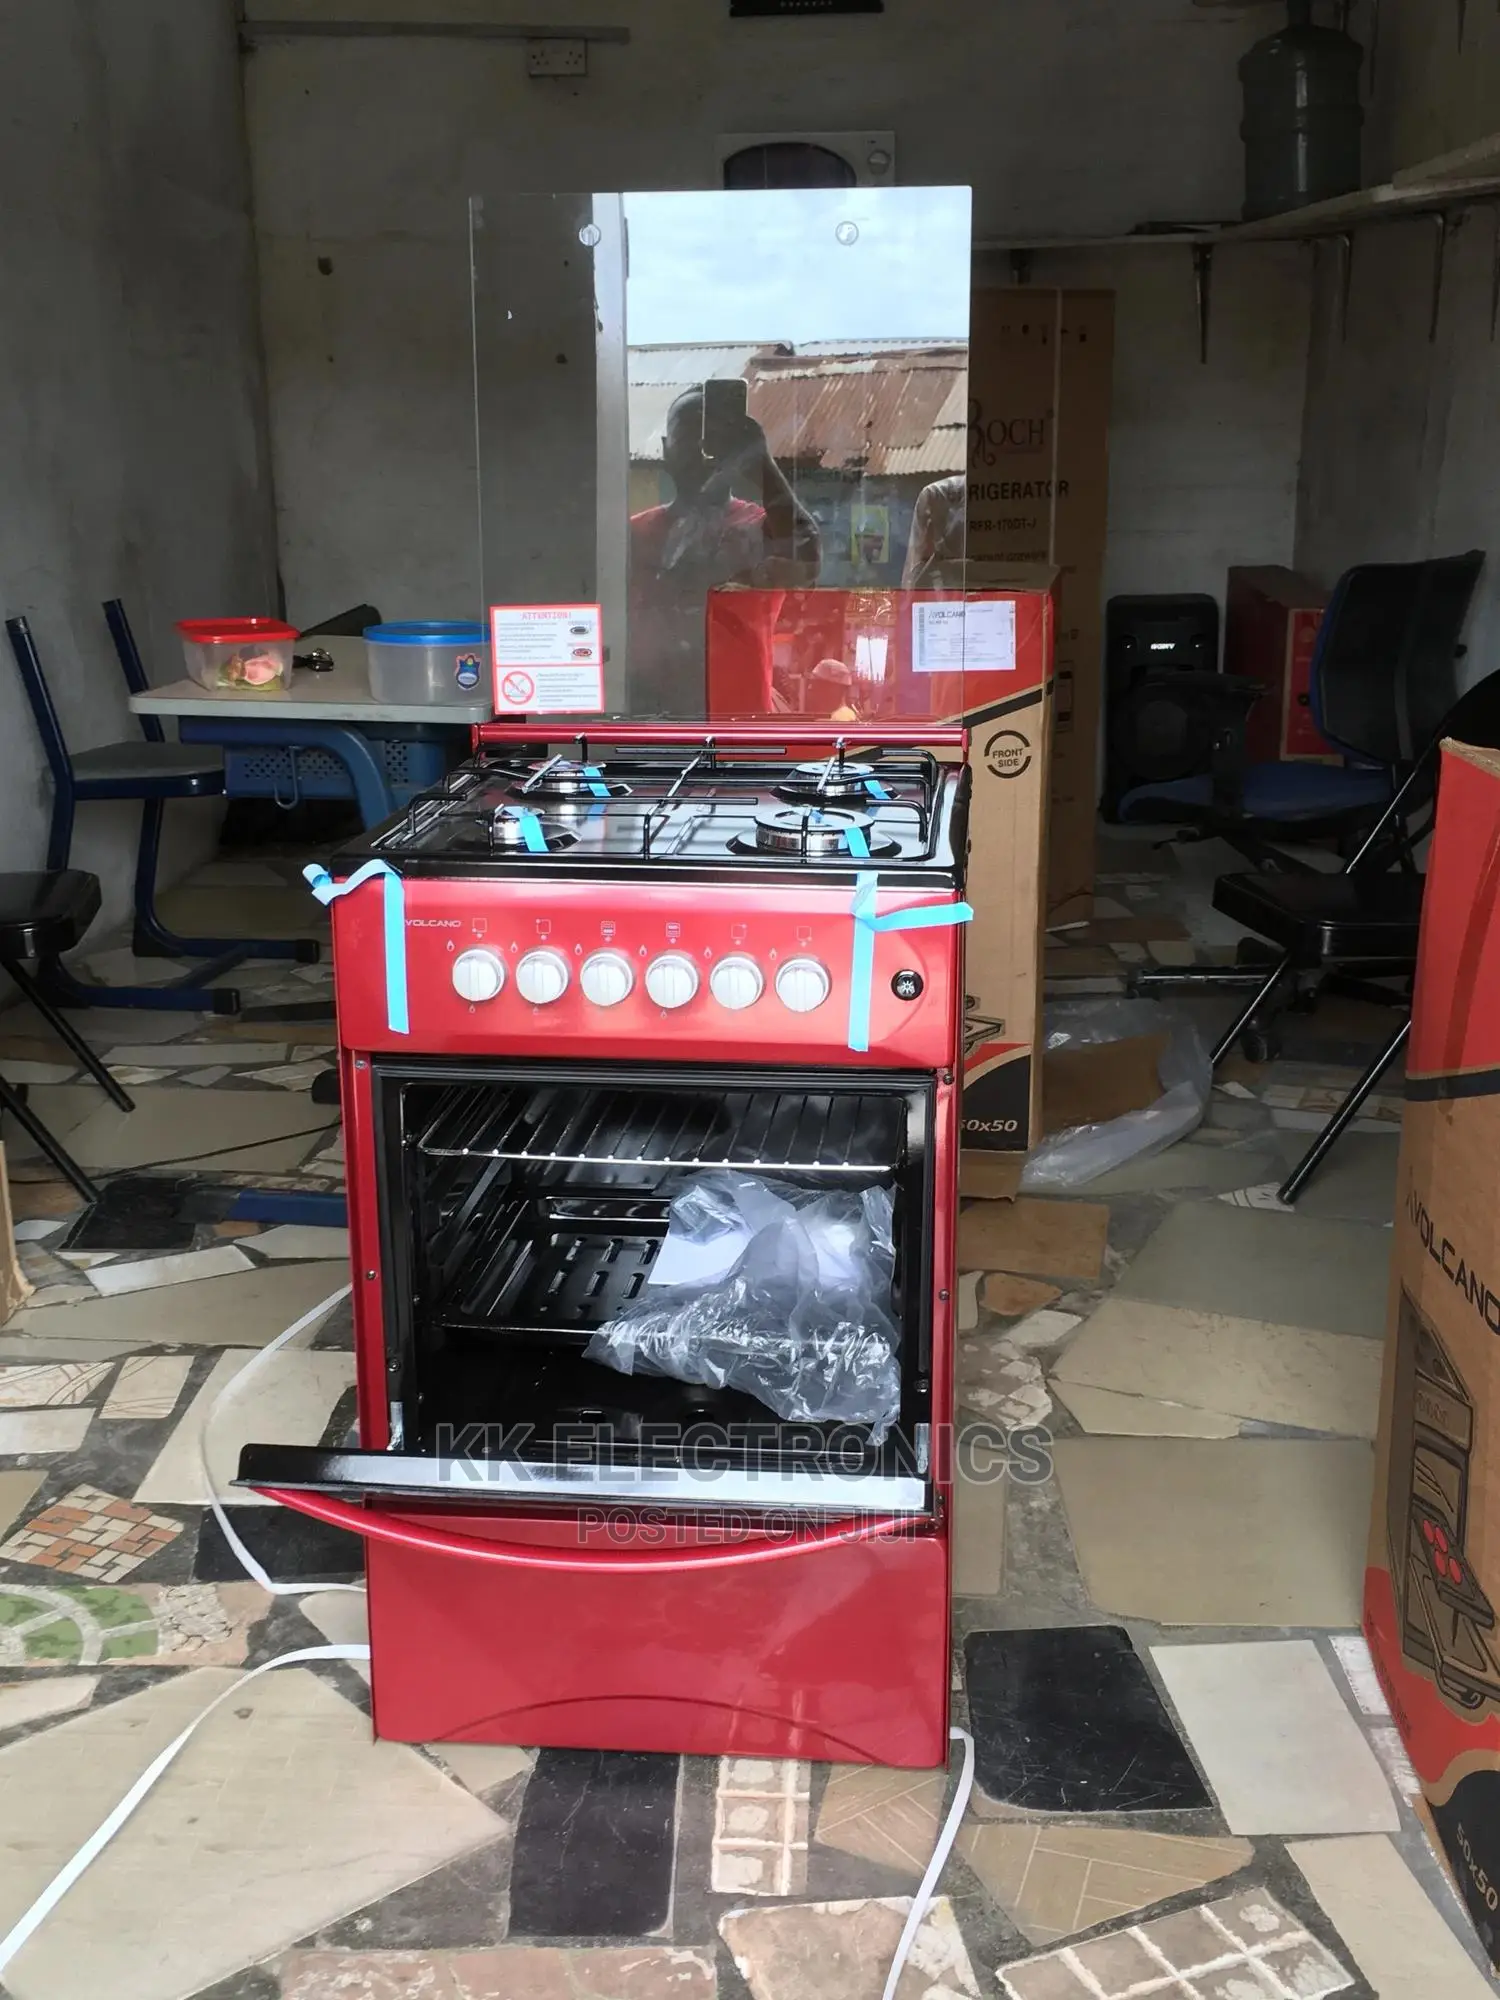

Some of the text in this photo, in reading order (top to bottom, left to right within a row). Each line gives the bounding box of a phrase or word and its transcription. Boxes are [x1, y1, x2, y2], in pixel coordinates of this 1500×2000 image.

[967, 398, 1045, 469] ROCH
[992, 748, 1024, 759] FRONT
[997, 759, 1020, 768] SIDE
[405, 919, 462, 928] VOLCANO
[1408, 1188, 1500, 1337] VOLCANO
[1456, 1822, 1499, 1912] 50x50
